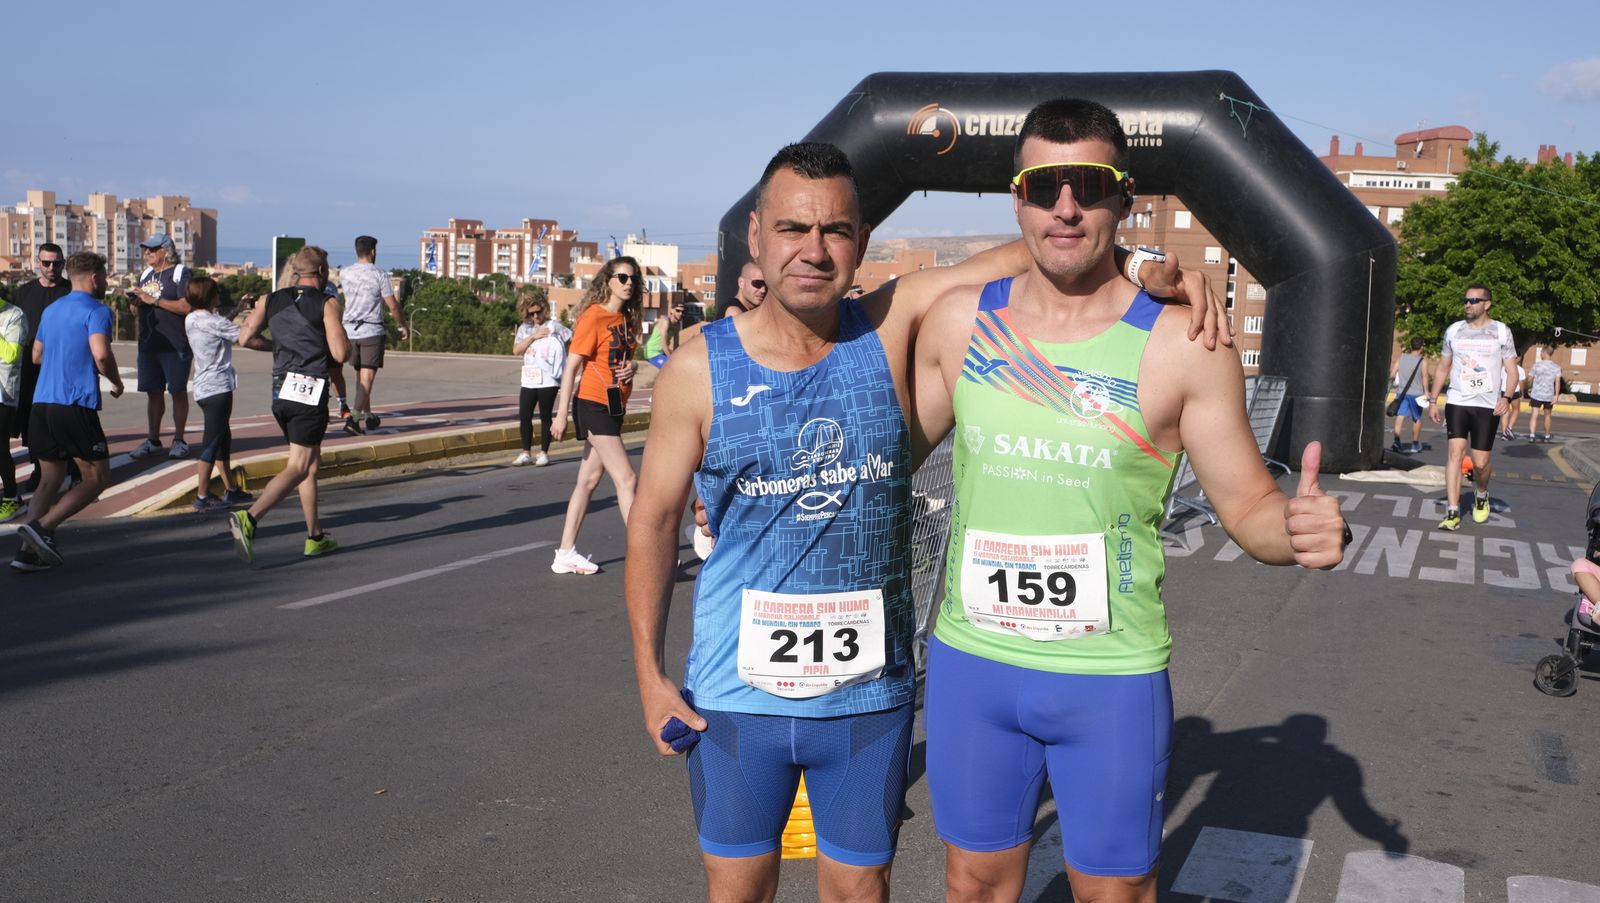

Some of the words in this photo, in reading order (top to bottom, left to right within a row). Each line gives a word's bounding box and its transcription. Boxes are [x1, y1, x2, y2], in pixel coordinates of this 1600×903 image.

[292, 382, 314, 396] 181
[1470, 379, 1484, 388] 35
[993, 433, 1113, 469] SAKATA
[736, 473, 817, 497] Carboneras
[820, 462, 857, 486] sabe
[1042, 472, 1053, 484] in
[1057, 473, 1090, 489] Seed
[983, 540, 1028, 556] CARRERA
[1031, 544, 1052, 556] SIN
[1054, 543, 1089, 556] HUMO
[1116, 513, 1134, 594] Atletismo
[988, 569, 1077, 607] 159
[763, 601, 814, 614] CARRERA
[817, 602, 836, 613] SIN
[839, 599, 869, 612] HUMO
[992, 604, 1003, 614] MI
[769, 628, 860, 663] 213
